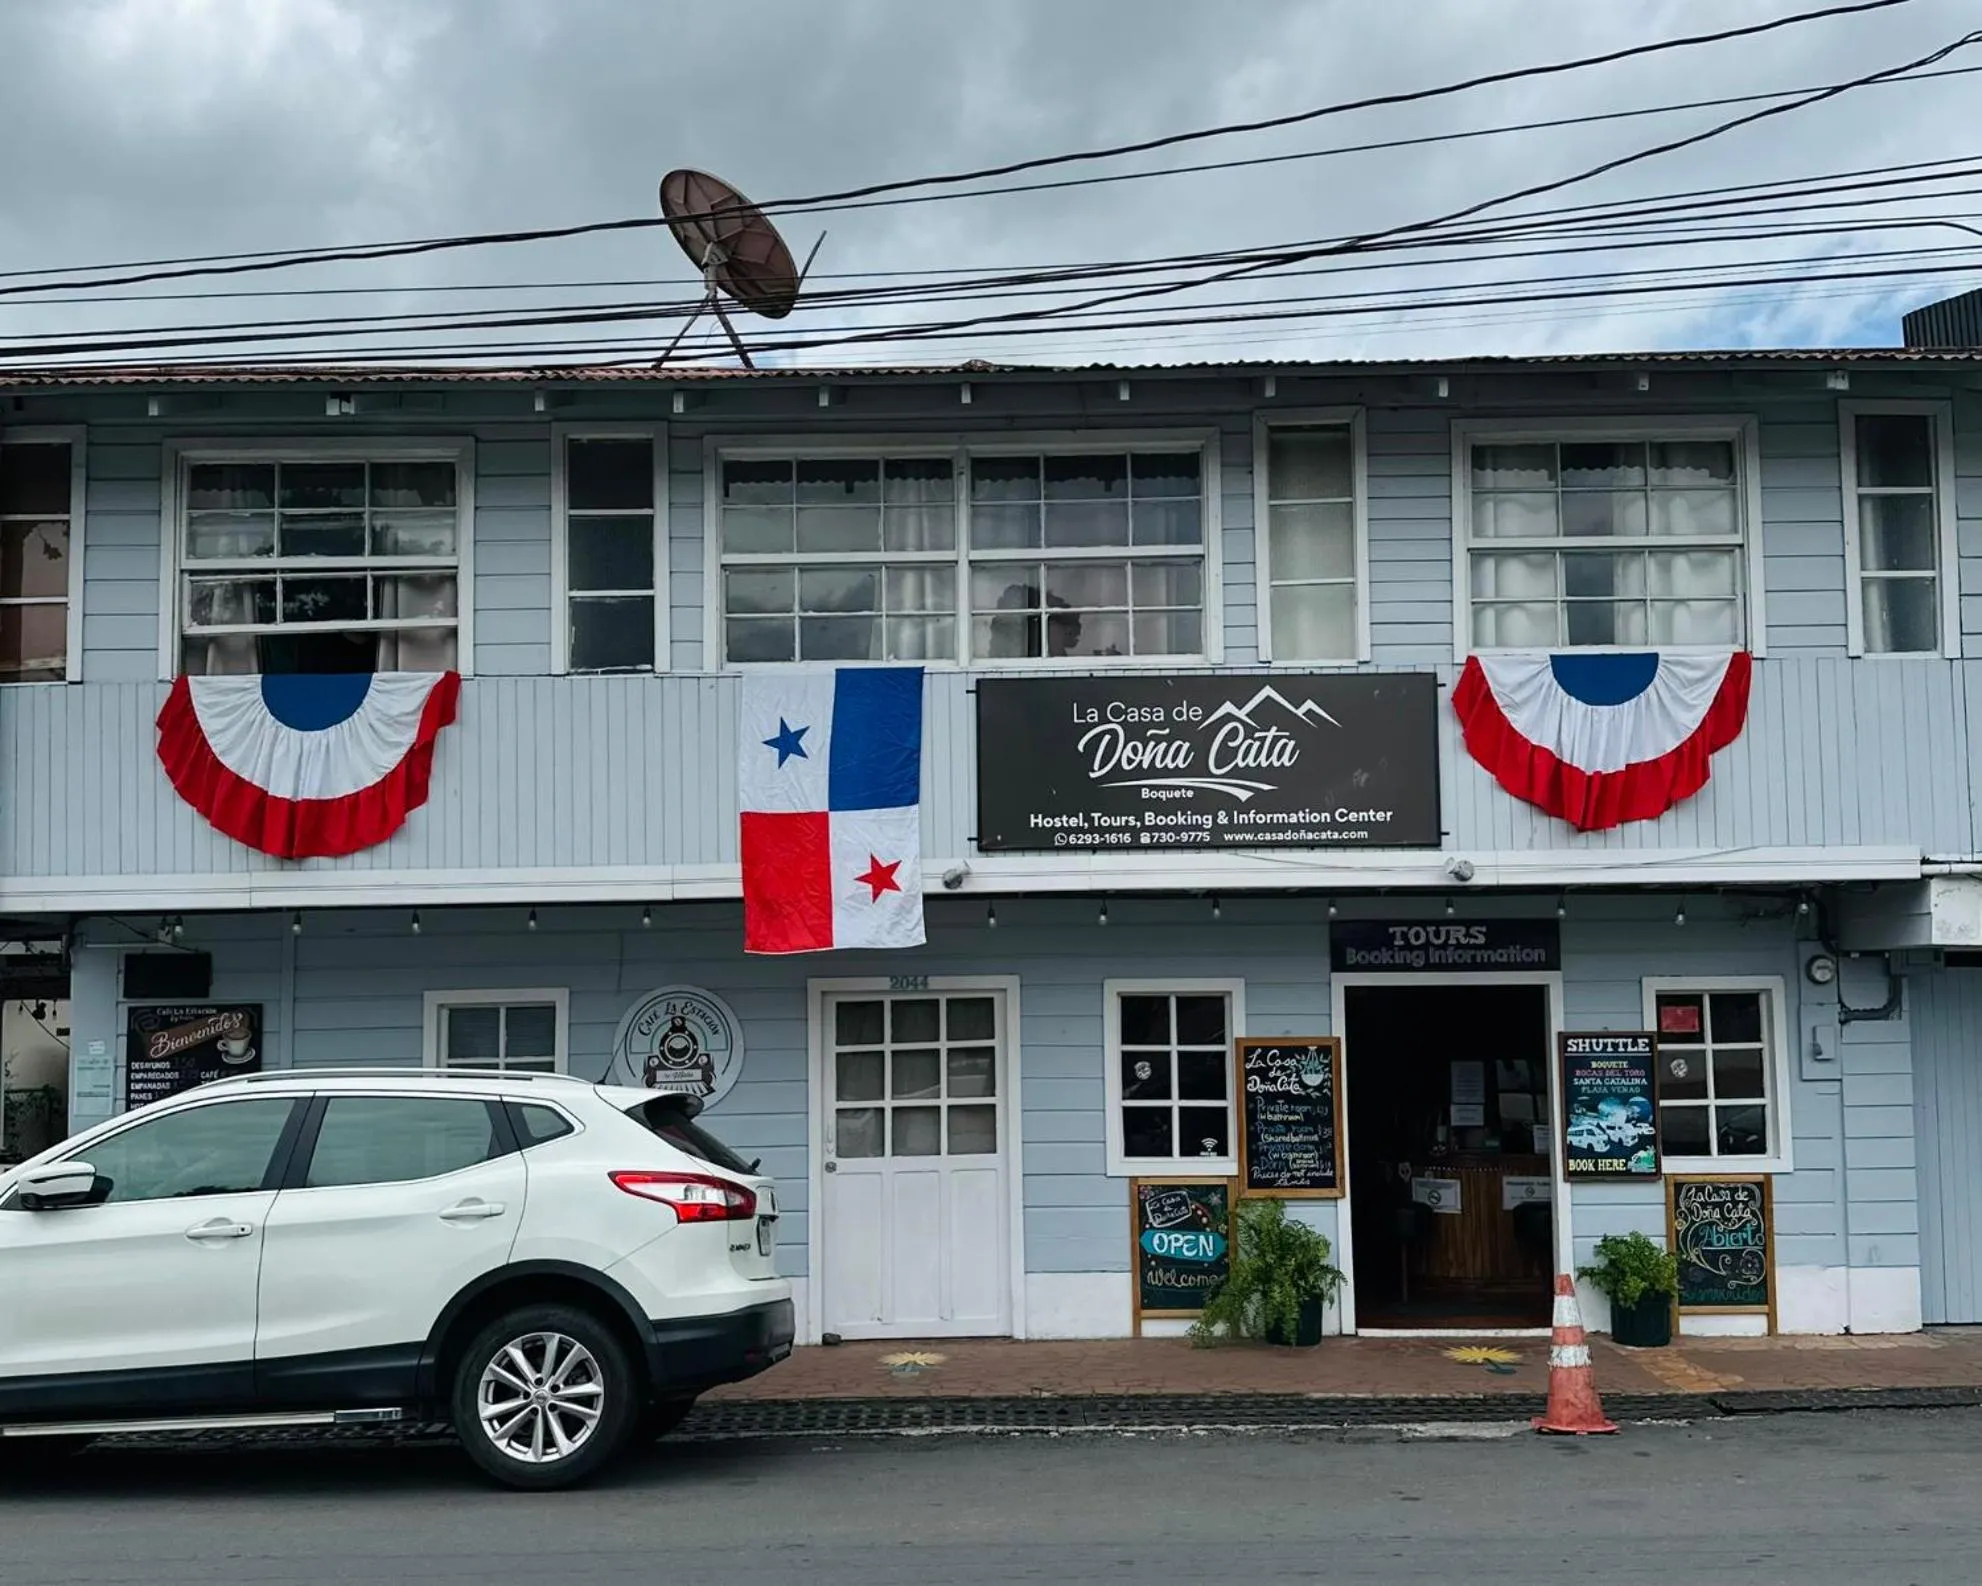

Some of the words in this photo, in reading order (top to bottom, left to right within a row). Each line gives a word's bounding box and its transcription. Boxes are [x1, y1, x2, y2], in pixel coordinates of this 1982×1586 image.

[1072, 702, 1100, 723] La
[1106, 702, 1165, 723] Casa
[1173, 701, 1203, 722] de
[1077, 723, 1195, 779] Doña
[1208, 721, 1300, 776] Cata
[1141, 787, 1195, 801] Boquete
[1029, 812, 1089, 829] Hostel,
[1091, 812, 1141, 830] Tours,
[1144, 811, 1213, 829] Booking
[1217, 811, 1230, 825] &
[1233, 808, 1332, 825] Information
[1335, 808, 1394, 823] Center
[1068, 833, 1132, 845] 6293-1616
[1151, 831, 1211, 845] 730-9775
[1223, 828, 1369, 843] www.casadoñacata.com
[1388, 925, 1487, 945] TOURS
[1345, 946, 1426, 967] Booking
[1429, 944, 1547, 964] Information
[889, 975, 929, 991] 2044
[1566, 1038, 1650, 1053] SHUTTLE
[130, 1061, 171, 1070] DESAYUNOS
[1245, 1047, 1267, 1069] La
[1266, 1049, 1299, 1067] Casa
[130, 1071, 180, 1080] EMPAREDADOS
[1277, 1073, 1304, 1095] Cata
[1573, 1078, 1603, 1086] SANTA
[1604, 1077, 1649, 1086] CATALINA
[130, 1081, 171, 1090] EMPANADAS
[1568, 1158, 1596, 1172] BOOK
[1597, 1158, 1627, 1172] HERE
[1723, 1202, 1753, 1219] Cata
[1699, 1222, 1766, 1247] Abierto
[1152, 1232, 1214, 1257] OPEN
[1146, 1267, 1219, 1288] Welcome
